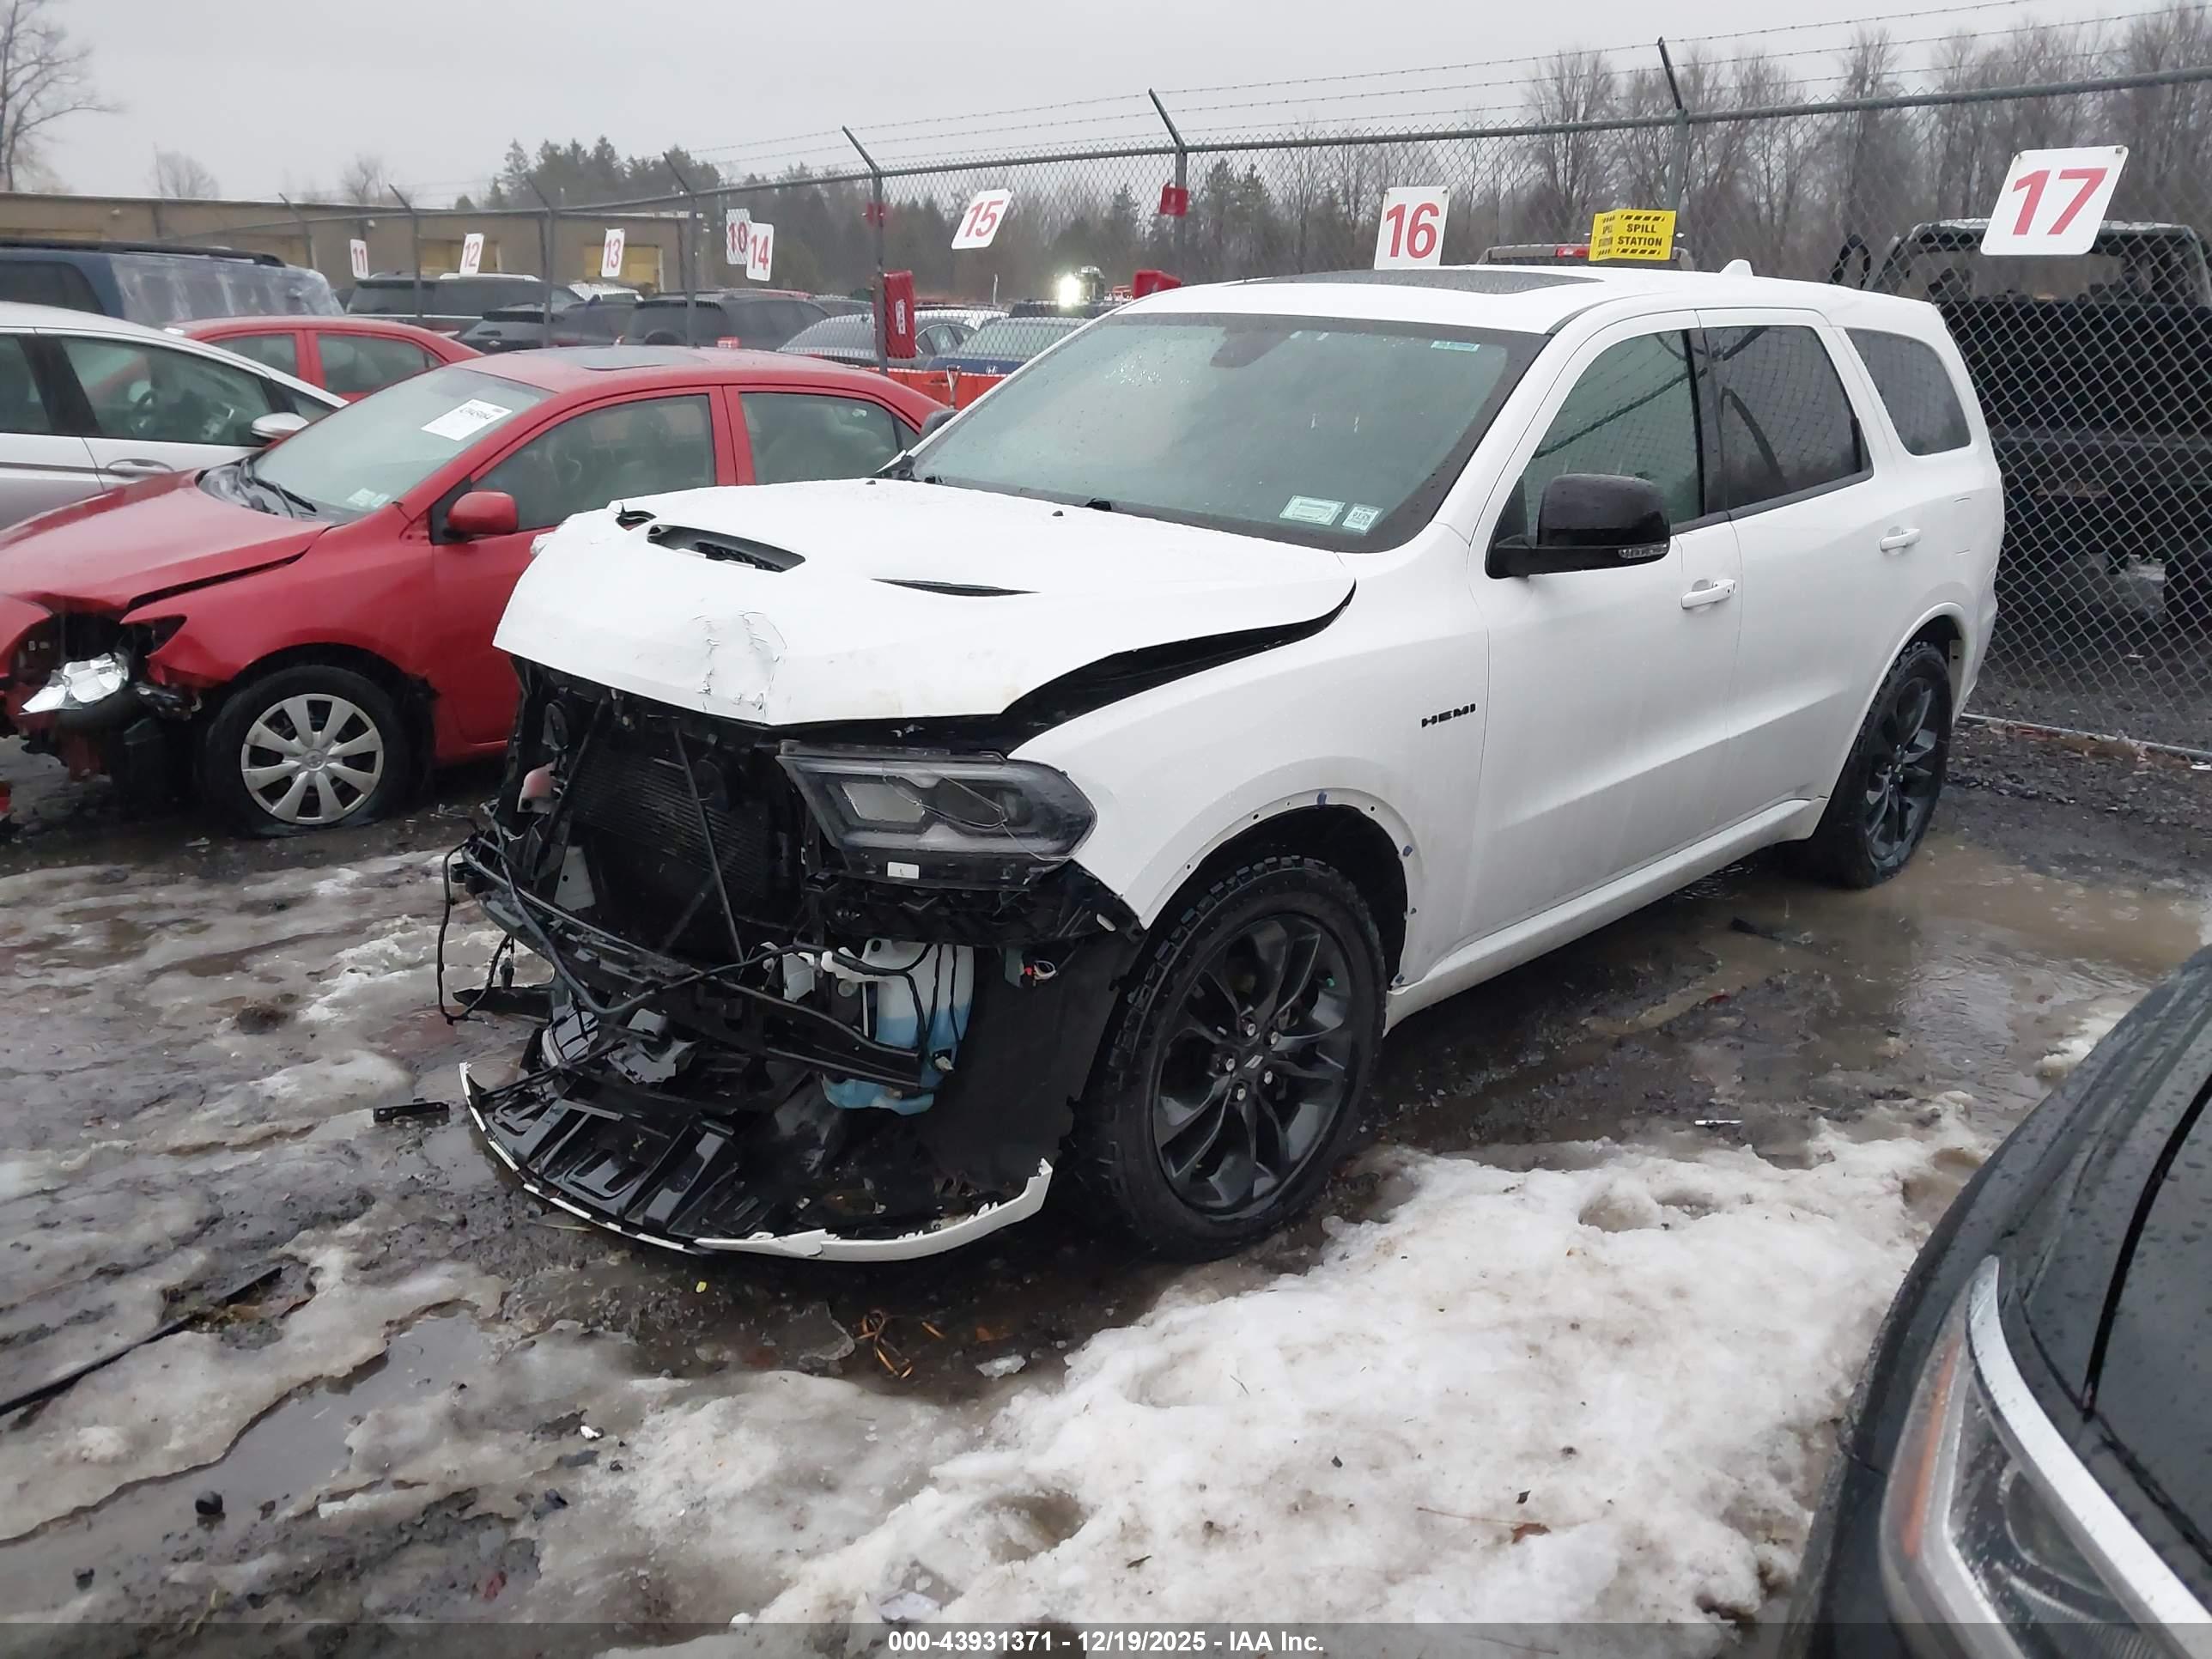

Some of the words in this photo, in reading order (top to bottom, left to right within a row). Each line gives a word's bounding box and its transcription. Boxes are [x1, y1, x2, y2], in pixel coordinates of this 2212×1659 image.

[2012, 167, 2109, 236] 17
[963, 199, 1004, 238] 15
[1386, 202, 1440, 259] 16
[1626, 222, 1657, 234] SPILL
[464, 238, 480, 269] 12
[605, 238, 621, 269] 13
[750, 234, 769, 270] 14
[1617, 235, 1663, 246] STATION
[352, 246, 367, 273] 11
[1421, 702, 1476, 729] HEMI
